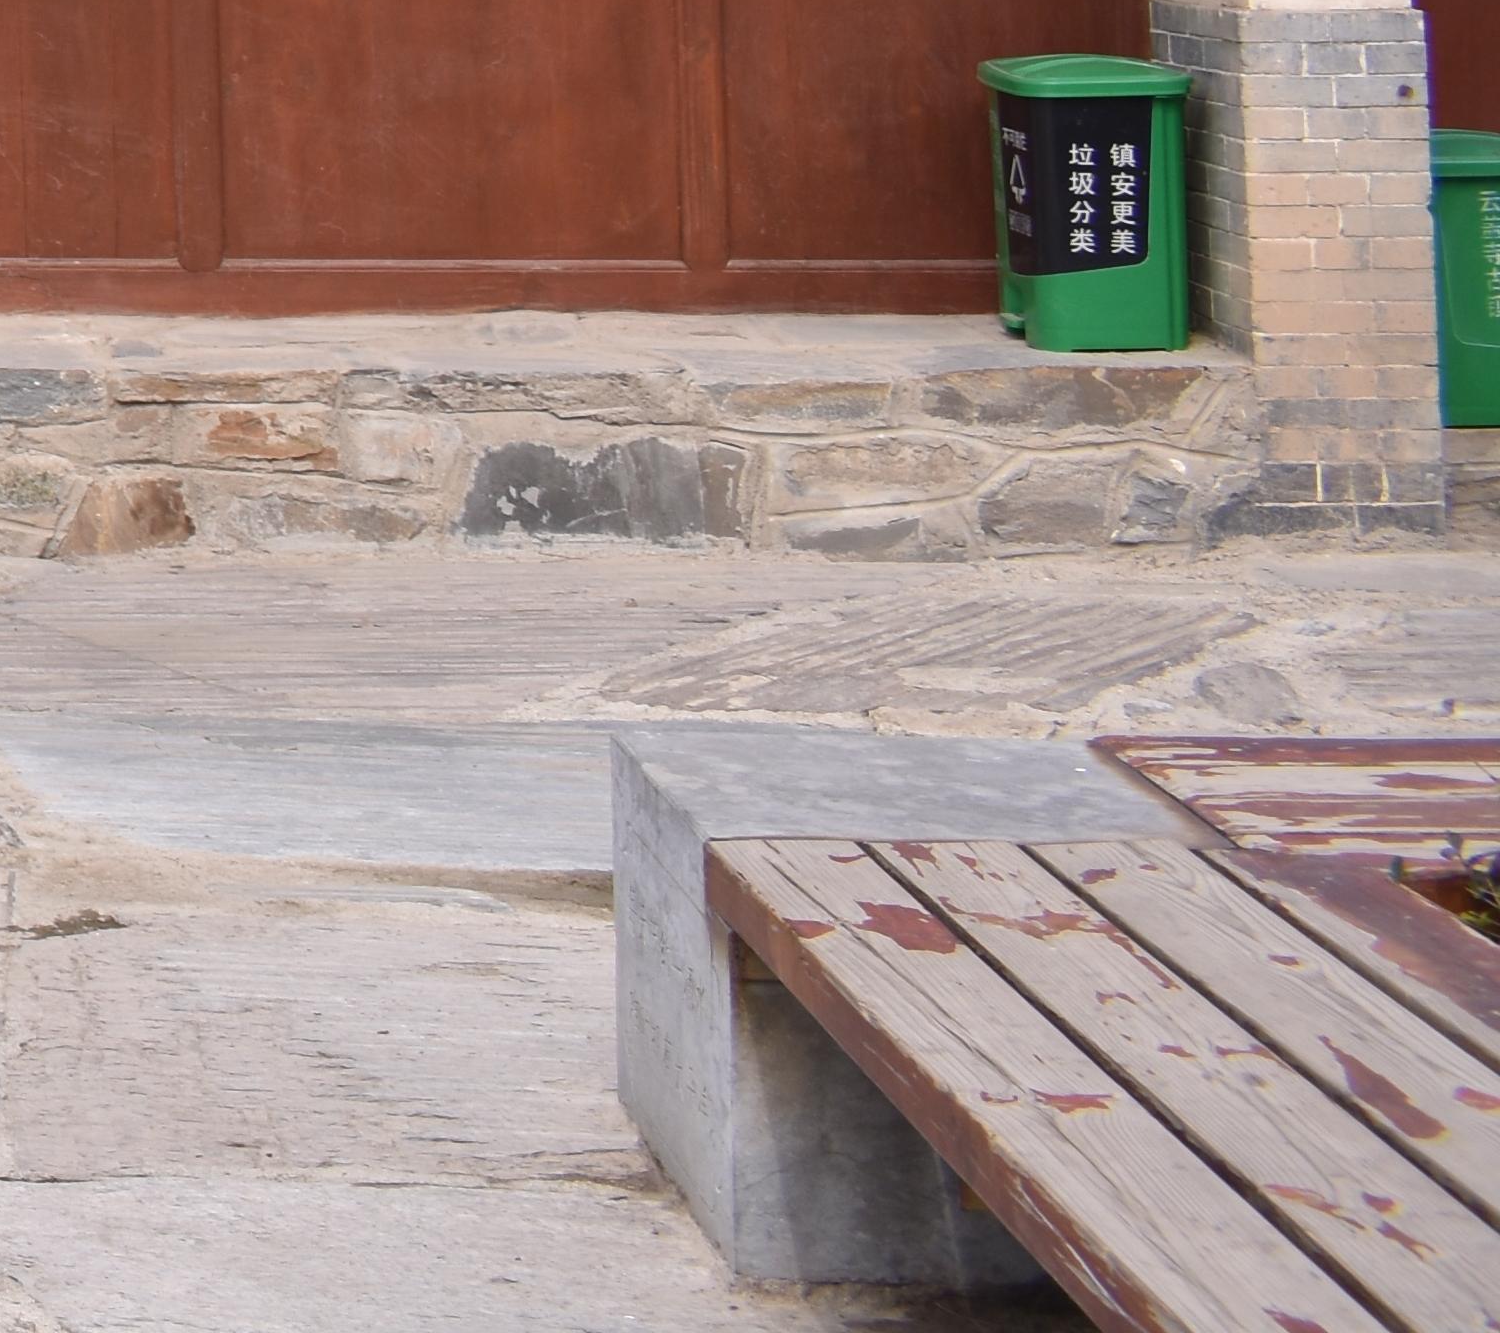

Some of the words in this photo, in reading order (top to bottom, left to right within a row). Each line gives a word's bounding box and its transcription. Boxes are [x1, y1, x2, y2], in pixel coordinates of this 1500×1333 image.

[1069, 143, 1095, 253] 垃圾分类
[1110, 143, 1137, 254] 镇安更美
